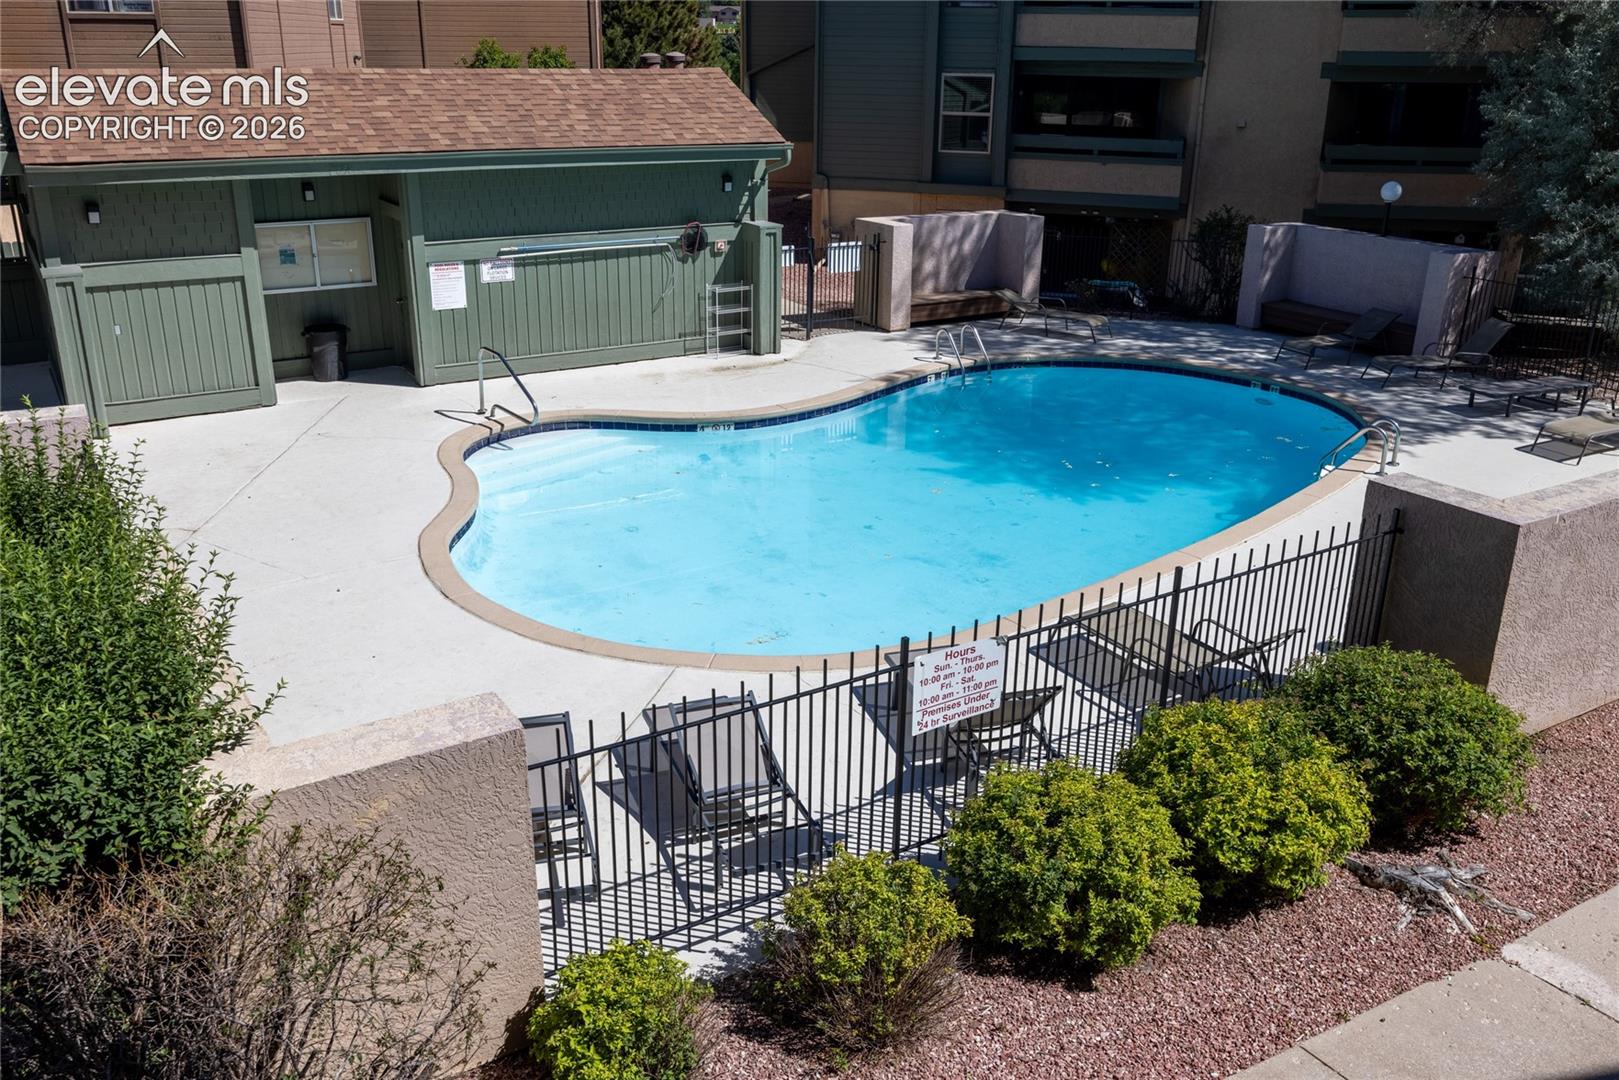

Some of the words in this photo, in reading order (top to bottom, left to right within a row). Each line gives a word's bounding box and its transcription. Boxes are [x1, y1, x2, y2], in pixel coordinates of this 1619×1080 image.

[934, 662, 953, 673] Sun.
[960, 654, 986, 666] Thurs.
[945, 646, 976, 661] Hours
[919, 675, 941, 688] 10:00
[943, 671, 956, 679] am
[963, 662, 985, 675] 10:00
[986, 659, 999, 670] pm
[940, 682, 954, 691] Fri.
[961, 675, 976, 685] Sat.
[919, 694, 940, 707] 10:00
[942, 691, 954, 699] am
[962, 682, 983, 694] 11:00
[984, 679, 998, 689] pm
[921, 700, 962, 719] Premises
[964, 691, 991, 706] Under
[918, 720, 929, 732] 24
[930, 718, 941, 728] hr
[942, 701, 995, 723] Surveillance
